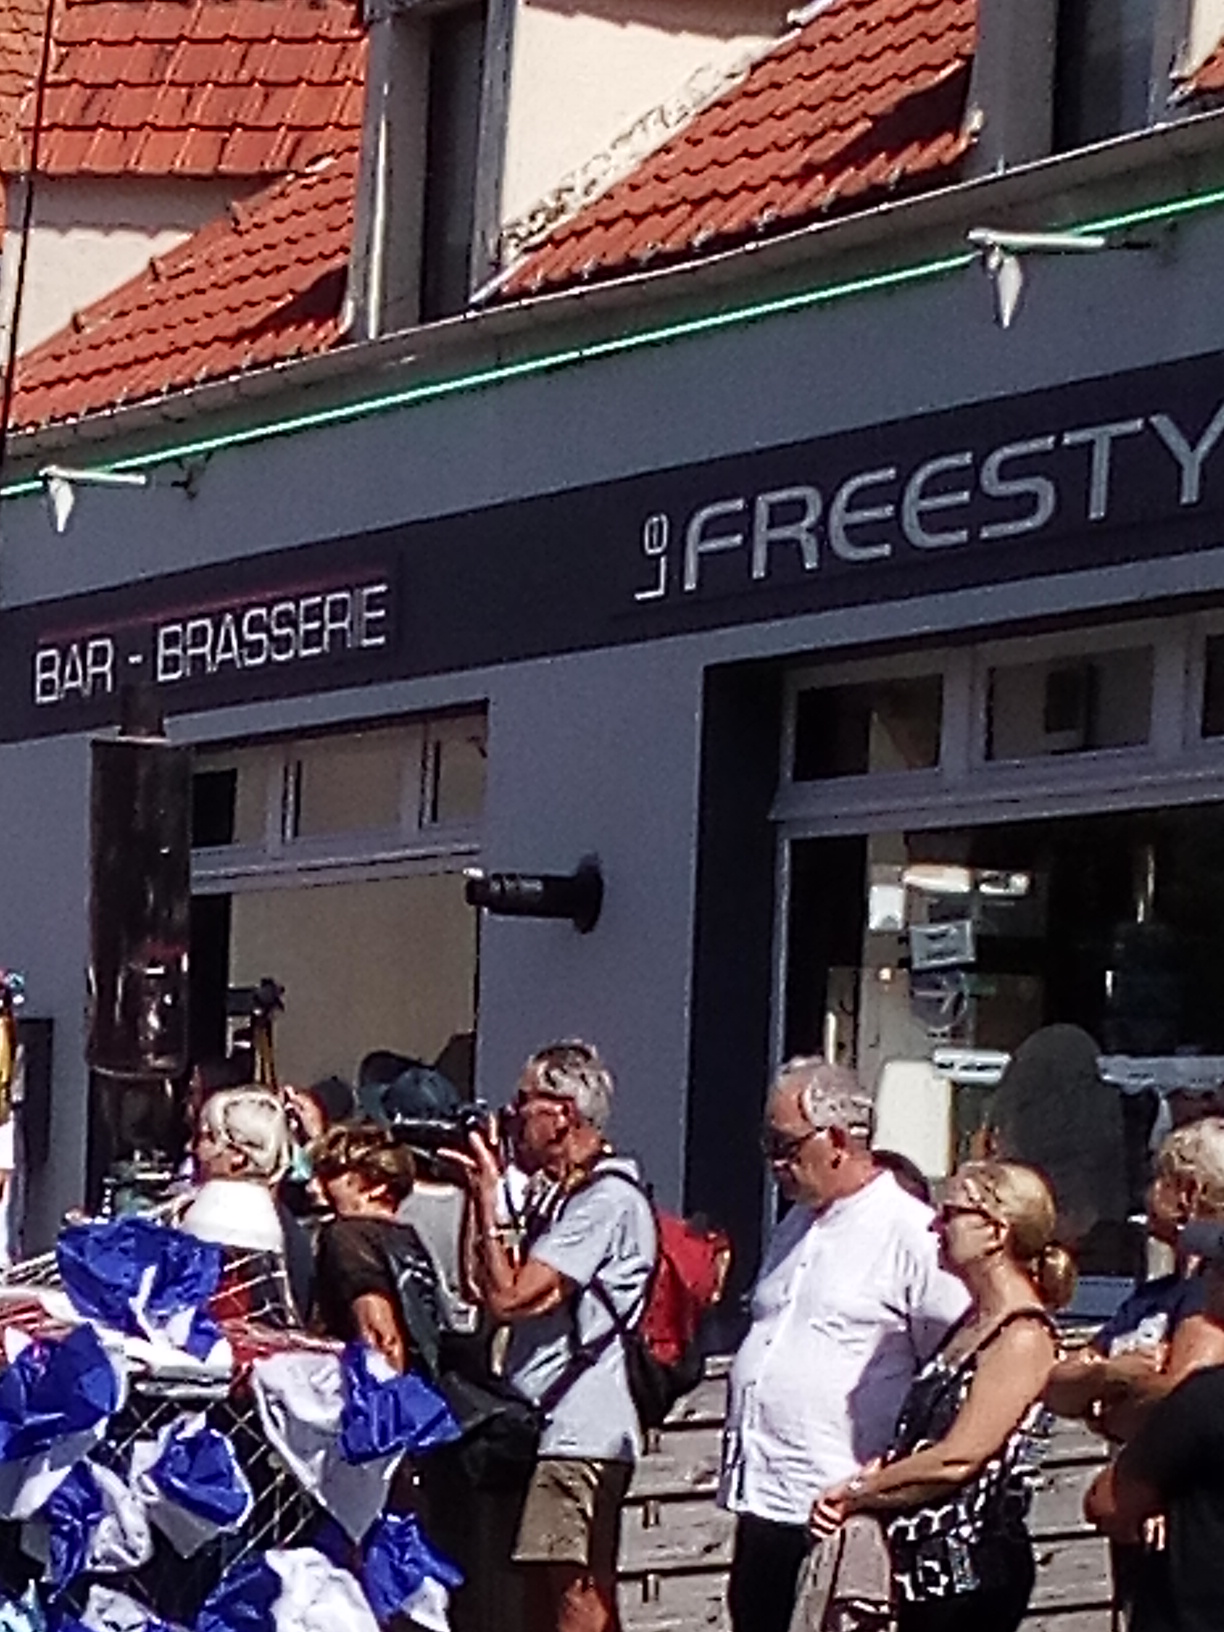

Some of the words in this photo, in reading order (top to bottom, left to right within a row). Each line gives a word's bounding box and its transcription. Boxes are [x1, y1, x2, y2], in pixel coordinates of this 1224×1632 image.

[683, 404, 1224, 591] FREESTY
[34, 638, 113, 705] BAR
[155, 583, 389, 682] BRASSERIE
